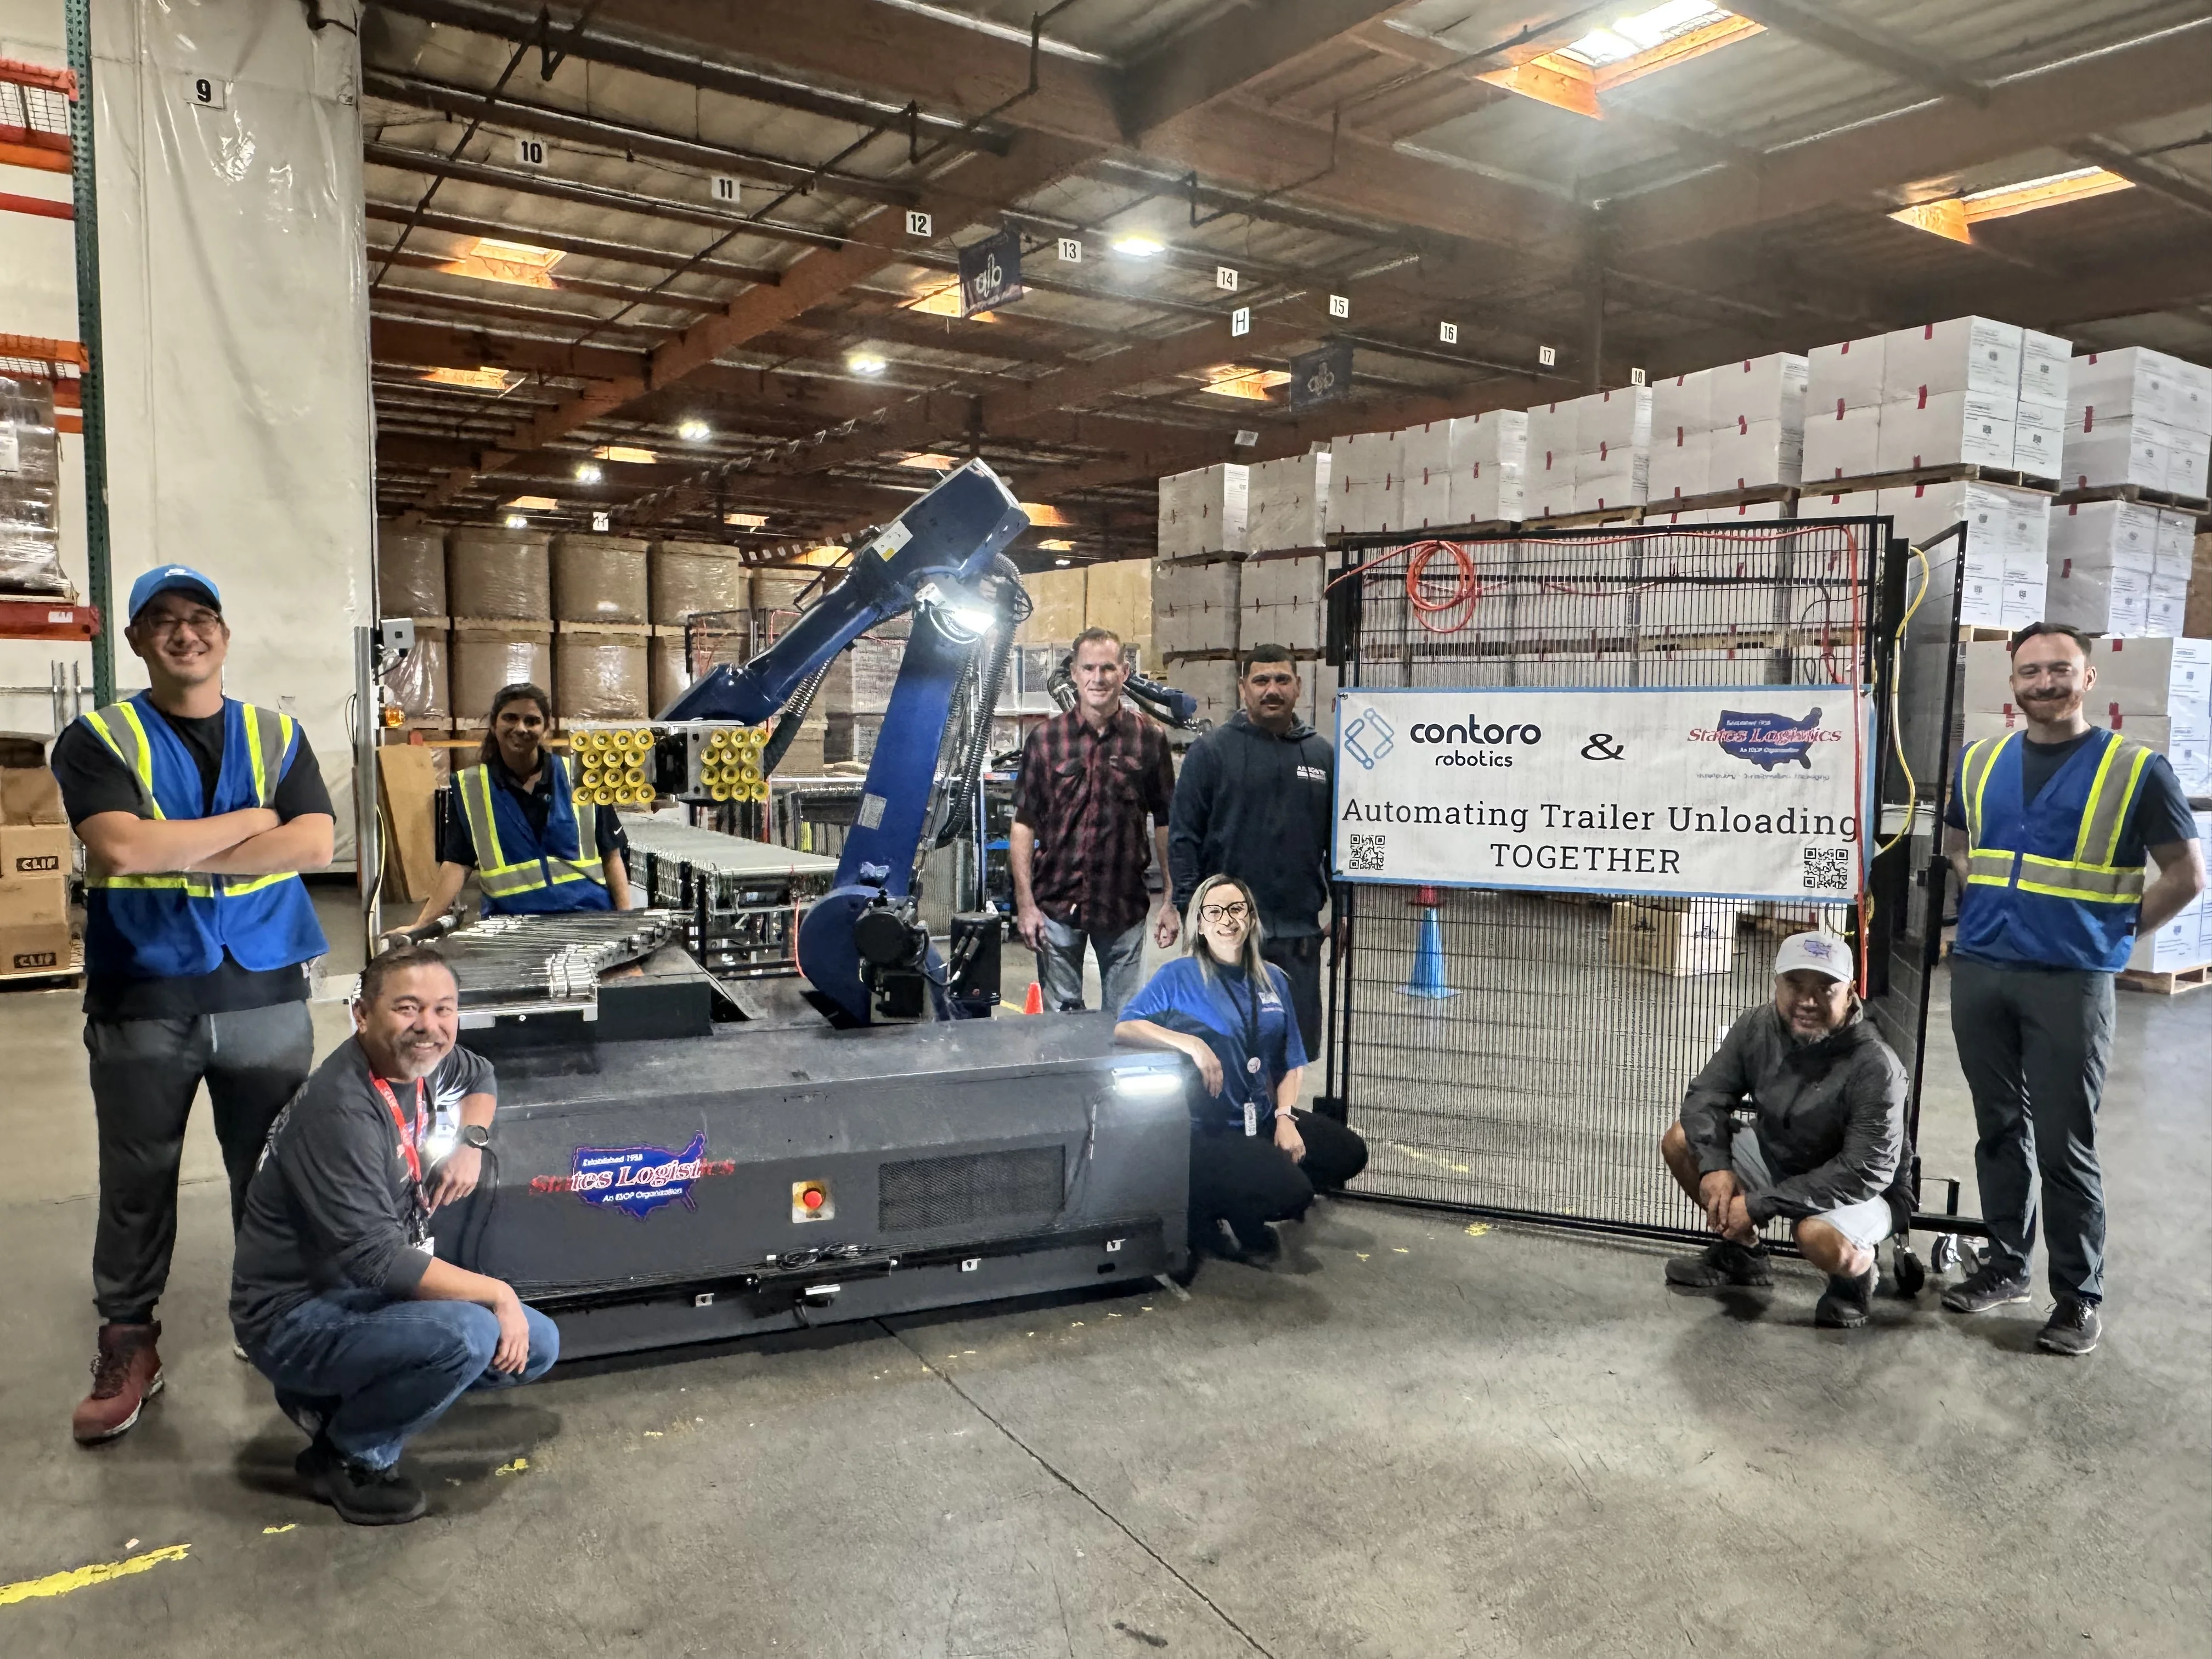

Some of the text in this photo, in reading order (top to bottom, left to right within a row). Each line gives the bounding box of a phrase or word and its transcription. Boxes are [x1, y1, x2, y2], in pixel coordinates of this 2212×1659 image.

[196, 80, 211, 103] 9
[521, 140, 542, 163] 10
[718, 179, 733, 200] 11
[911, 214, 927, 233] 12
[1063, 241, 1076, 259] 13
[1222, 271, 1233, 287] 14
[1334, 300, 1345, 315] 15
[1236, 312, 1245, 332] H
[1444, 325, 1454, 341] 16
[1543, 350, 1551, 363] 17
[1635, 370, 1643, 383] 18
[1410, 714, 1541, 744] contoro
[1687, 727, 1842, 746] States Logistics
[1581, 734, 1625, 761] &
[1435, 751, 1513, 767] robotics
[1342, 799, 1857, 842] Automating Trailer Unloading
[1491, 843, 1680, 874] TOGETHER
